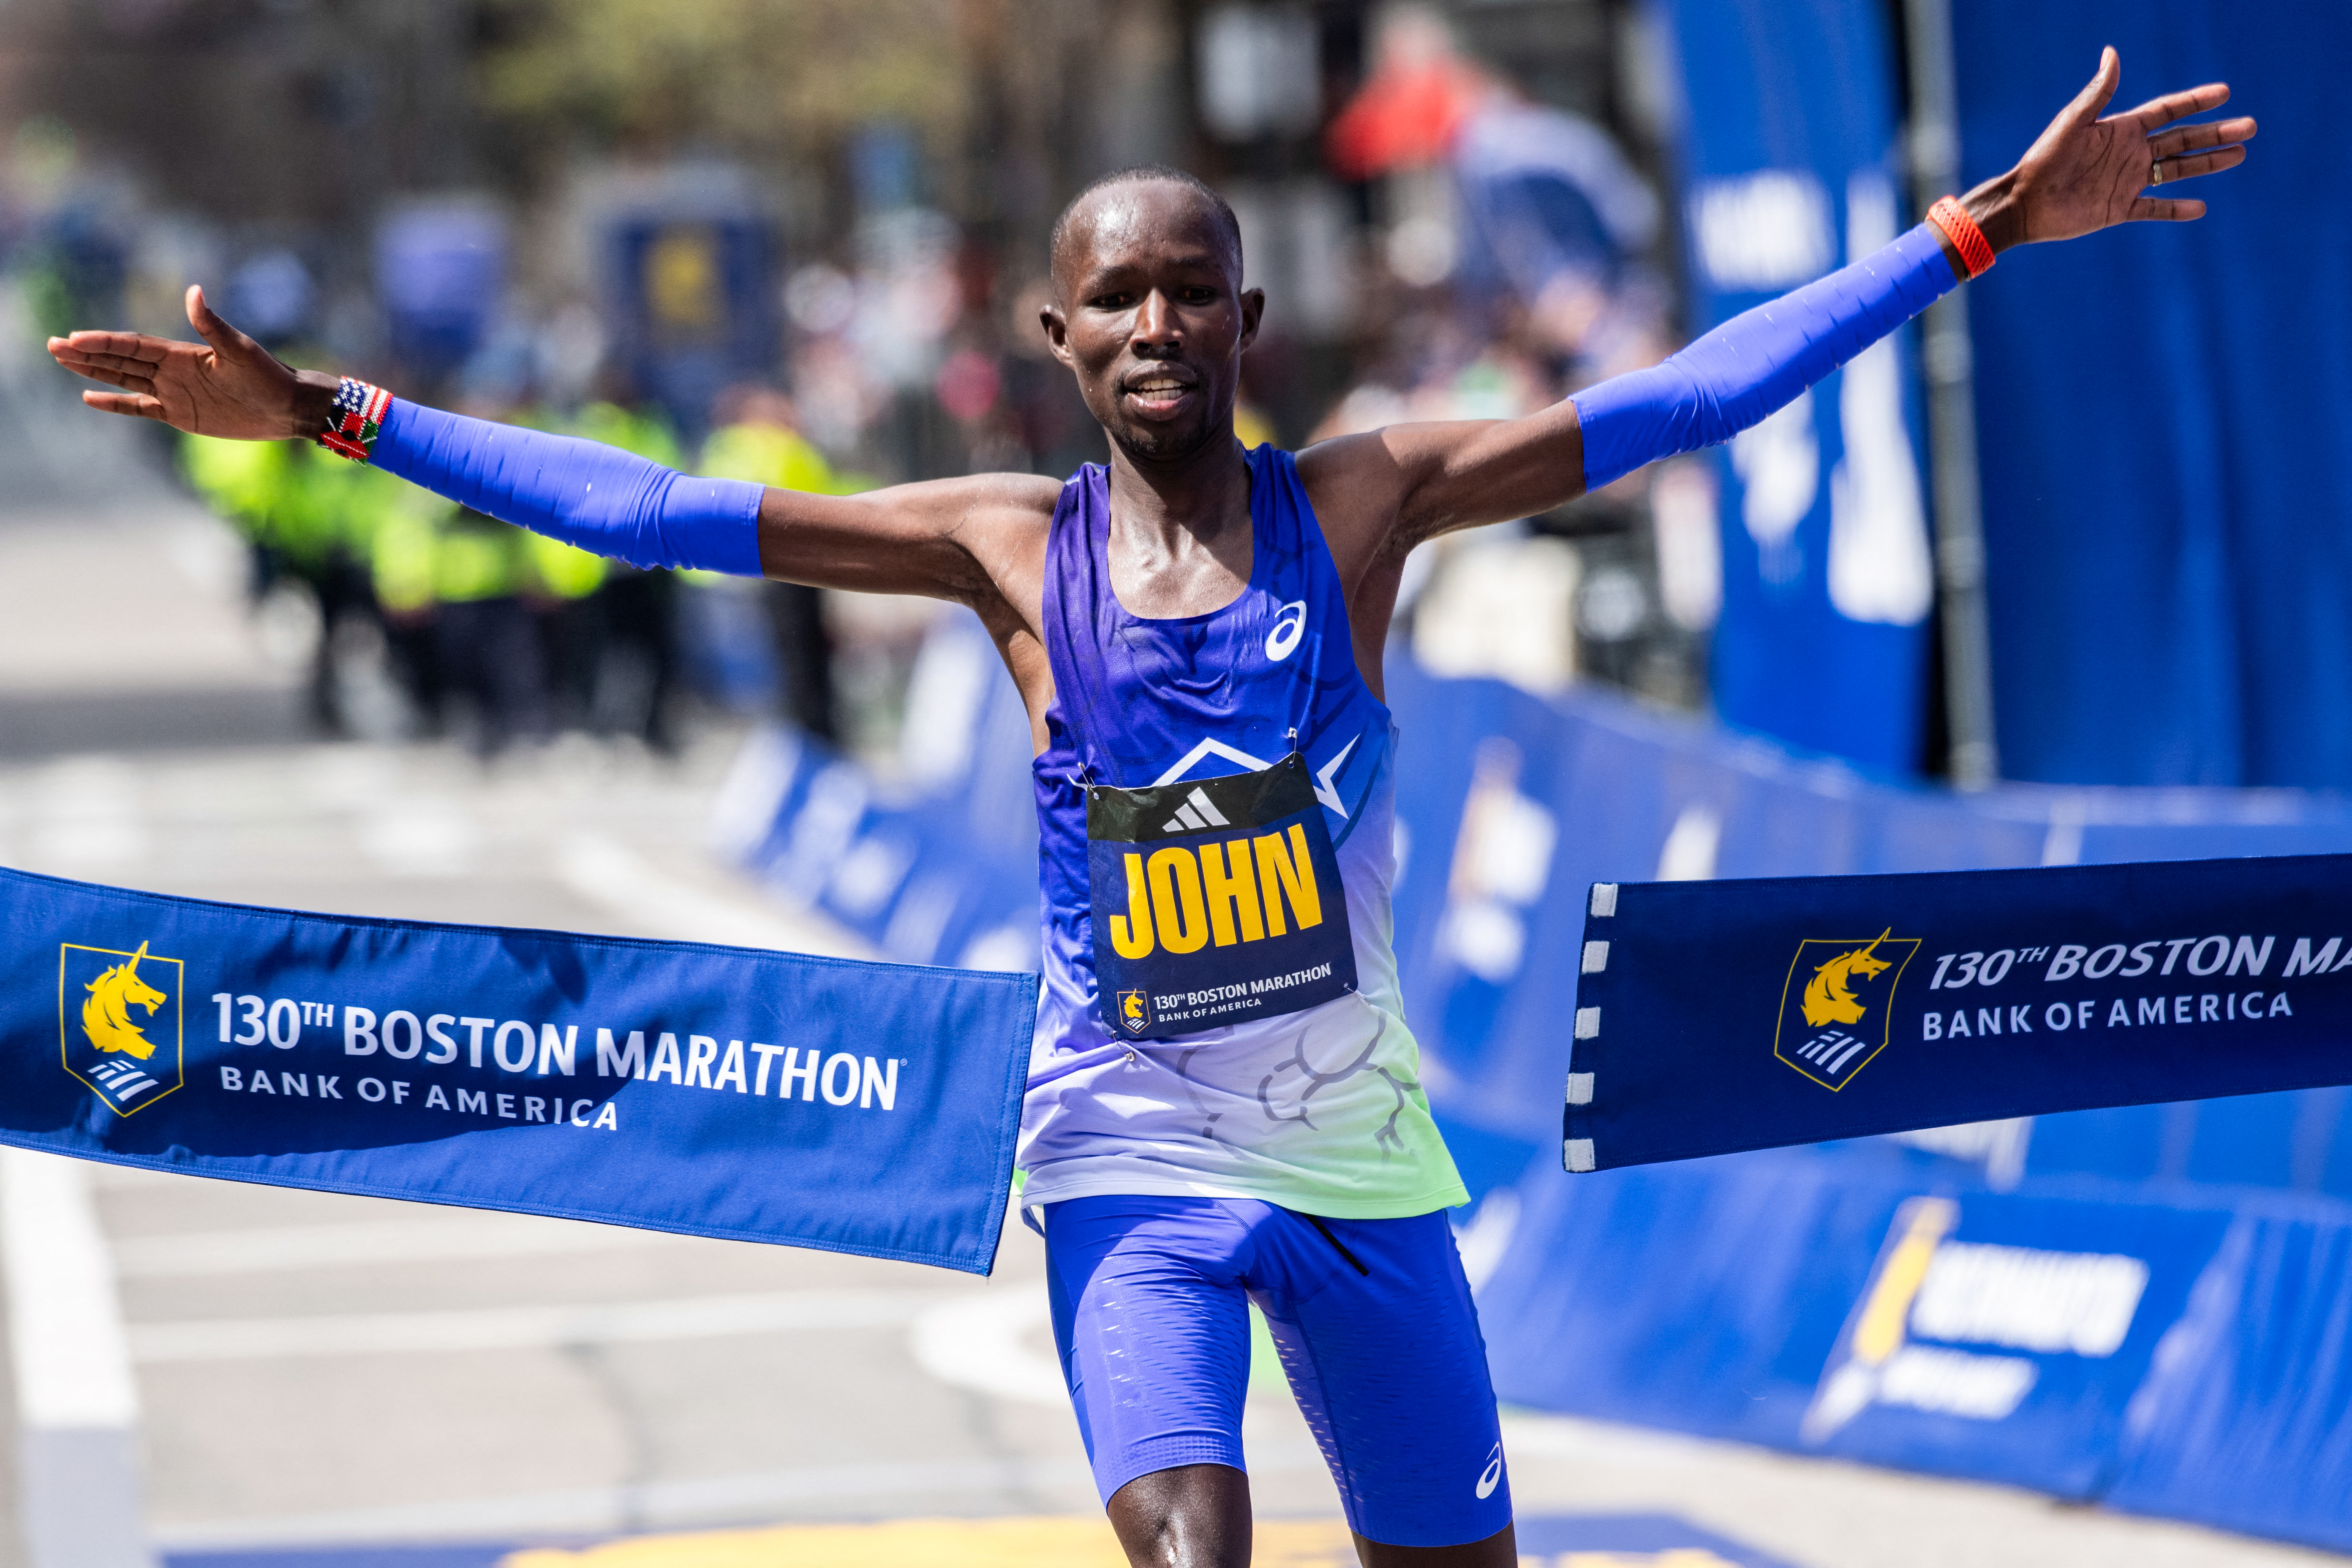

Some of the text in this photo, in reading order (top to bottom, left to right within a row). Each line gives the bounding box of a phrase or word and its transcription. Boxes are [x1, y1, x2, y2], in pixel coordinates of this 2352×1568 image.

[1109, 823, 1323, 960] JOHN
[1154, 962, 1331, 1010] 130TH BOSTON MARATHON
[1929, 946, 2050, 990] 130TH
[2044, 935, 2275, 981] BOSTON
[212, 993, 335, 1049] 130TH
[343, 1006, 579, 1076] BOSTON
[1159, 998, 1262, 1022] BANK OF AMERICA
[1923, 992, 2292, 1040] BANK OF AMERICA
[221, 1066, 618, 1131] BANK OF AMERICA
